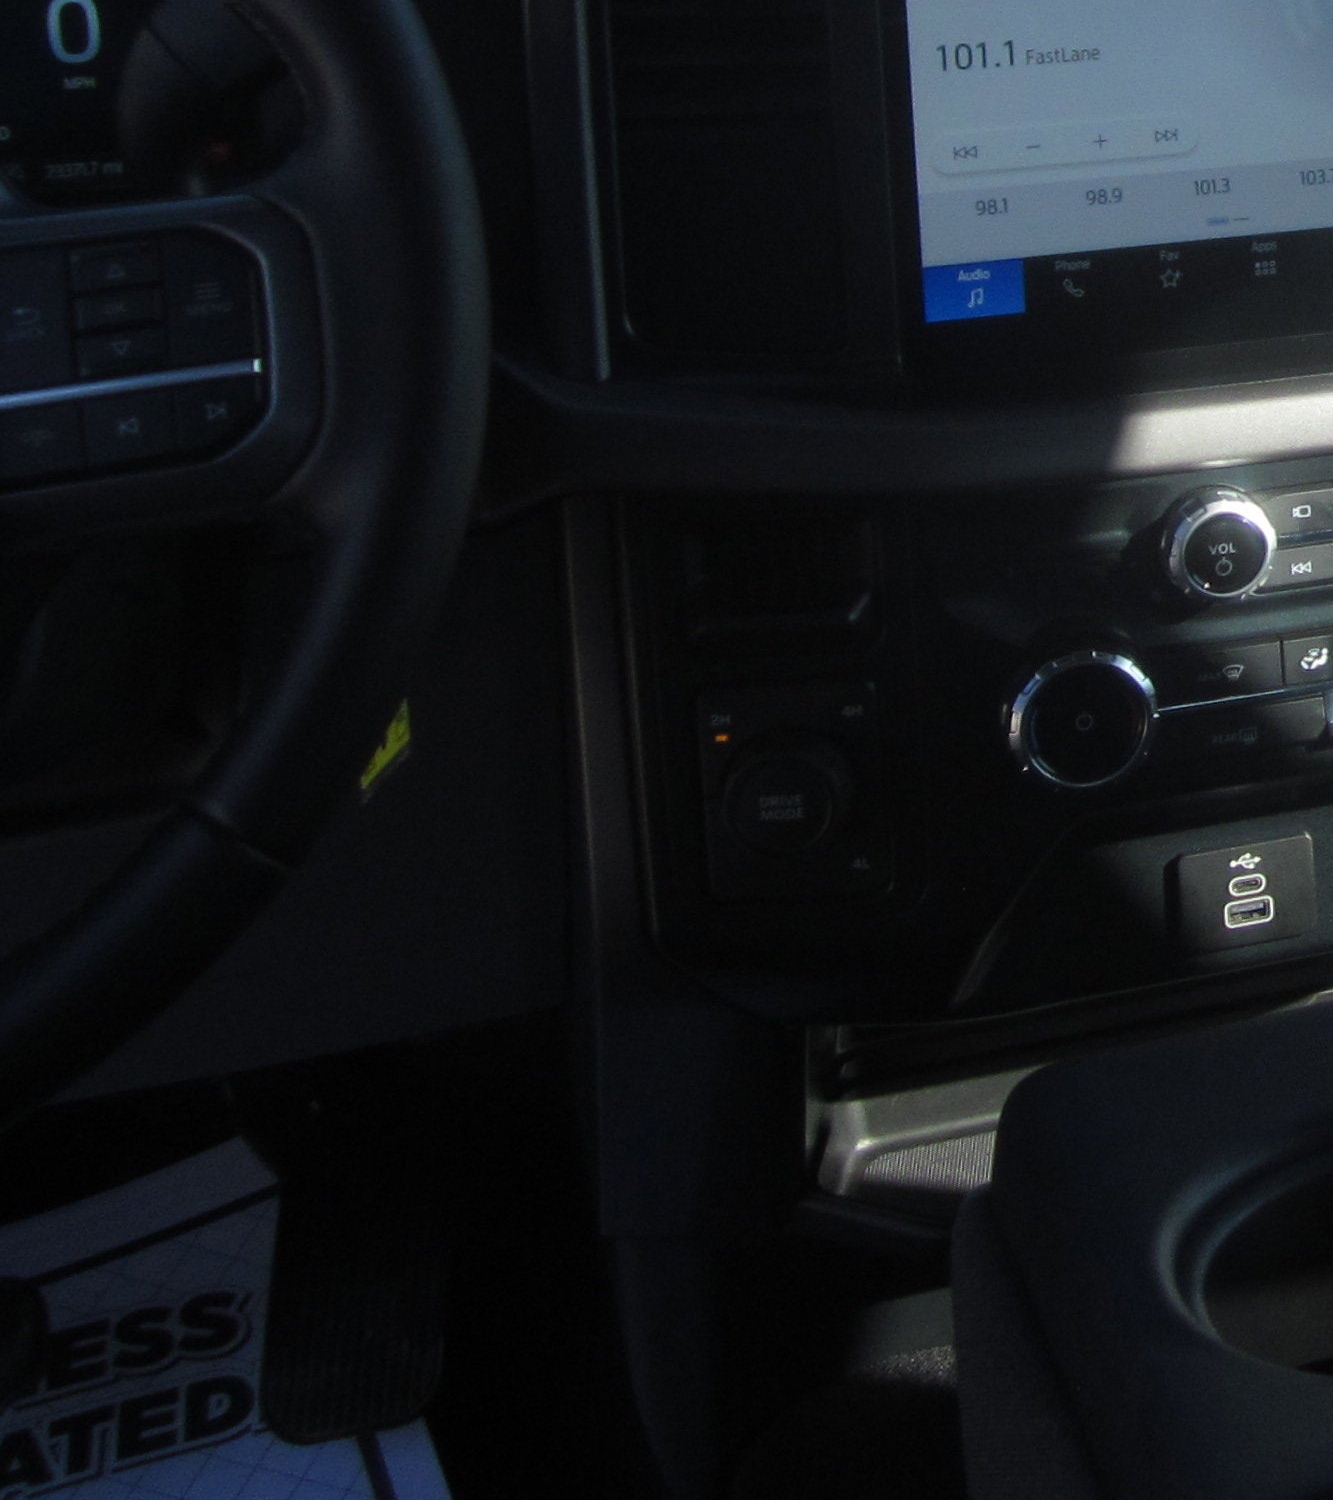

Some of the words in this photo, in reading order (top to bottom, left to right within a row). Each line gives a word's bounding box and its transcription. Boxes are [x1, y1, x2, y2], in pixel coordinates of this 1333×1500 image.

[935, 40, 1015, 71] 101.1
[1025, 46, 1101, 66] FastLane
[1086, 187, 1123, 206] 98.9
[1193, 178, 1231, 197] 101.3
[975, 197, 1009, 216] 98.1
[957, 269, 991, 282] Audio
[1208, 542, 1237, 556] VOL
